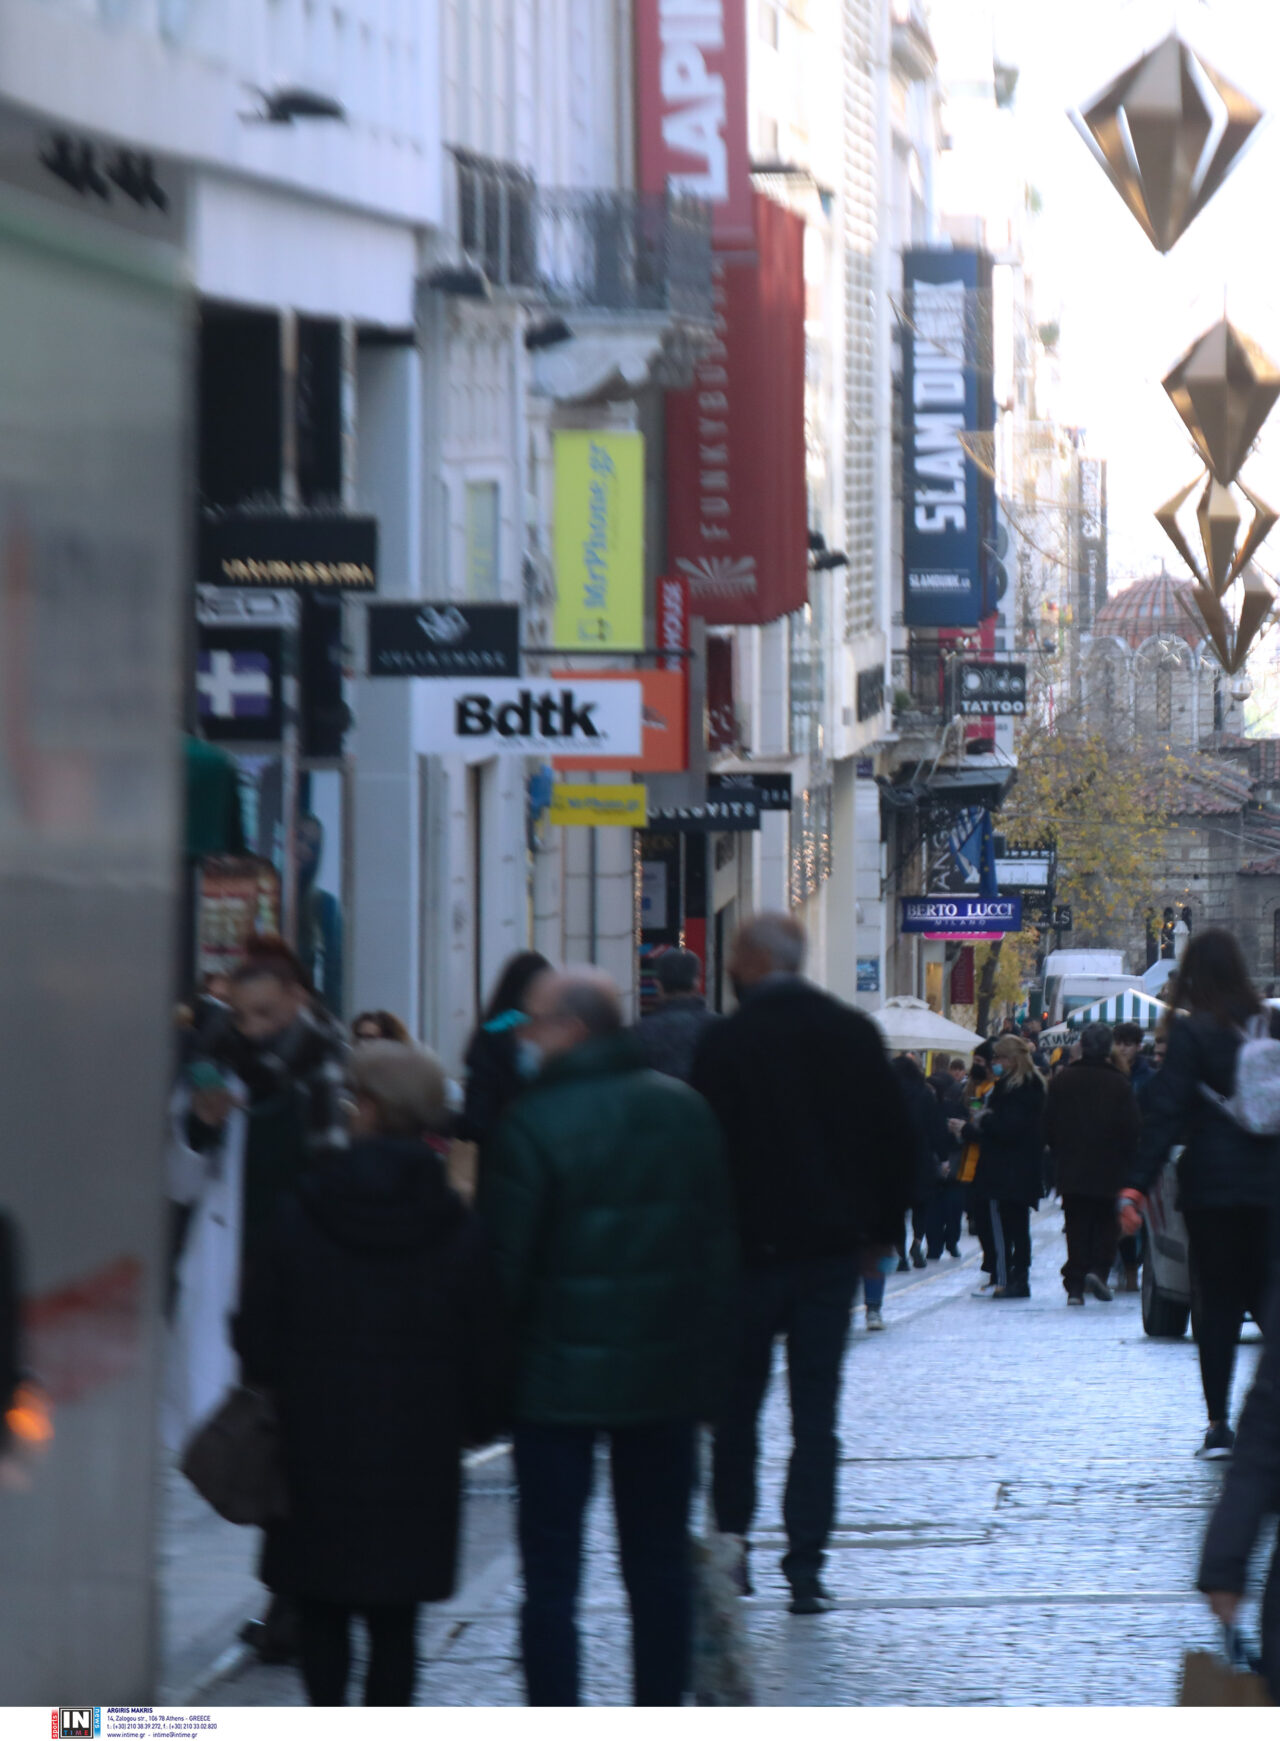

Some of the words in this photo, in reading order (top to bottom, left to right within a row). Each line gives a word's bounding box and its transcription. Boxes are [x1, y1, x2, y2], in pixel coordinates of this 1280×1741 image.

[913, 279, 966, 533] SLAMDUNK
[961, 700, 1024, 713] TATTOO
[907, 904, 958, 917] BERTO
[967, 904, 1013, 917] LUCCI
